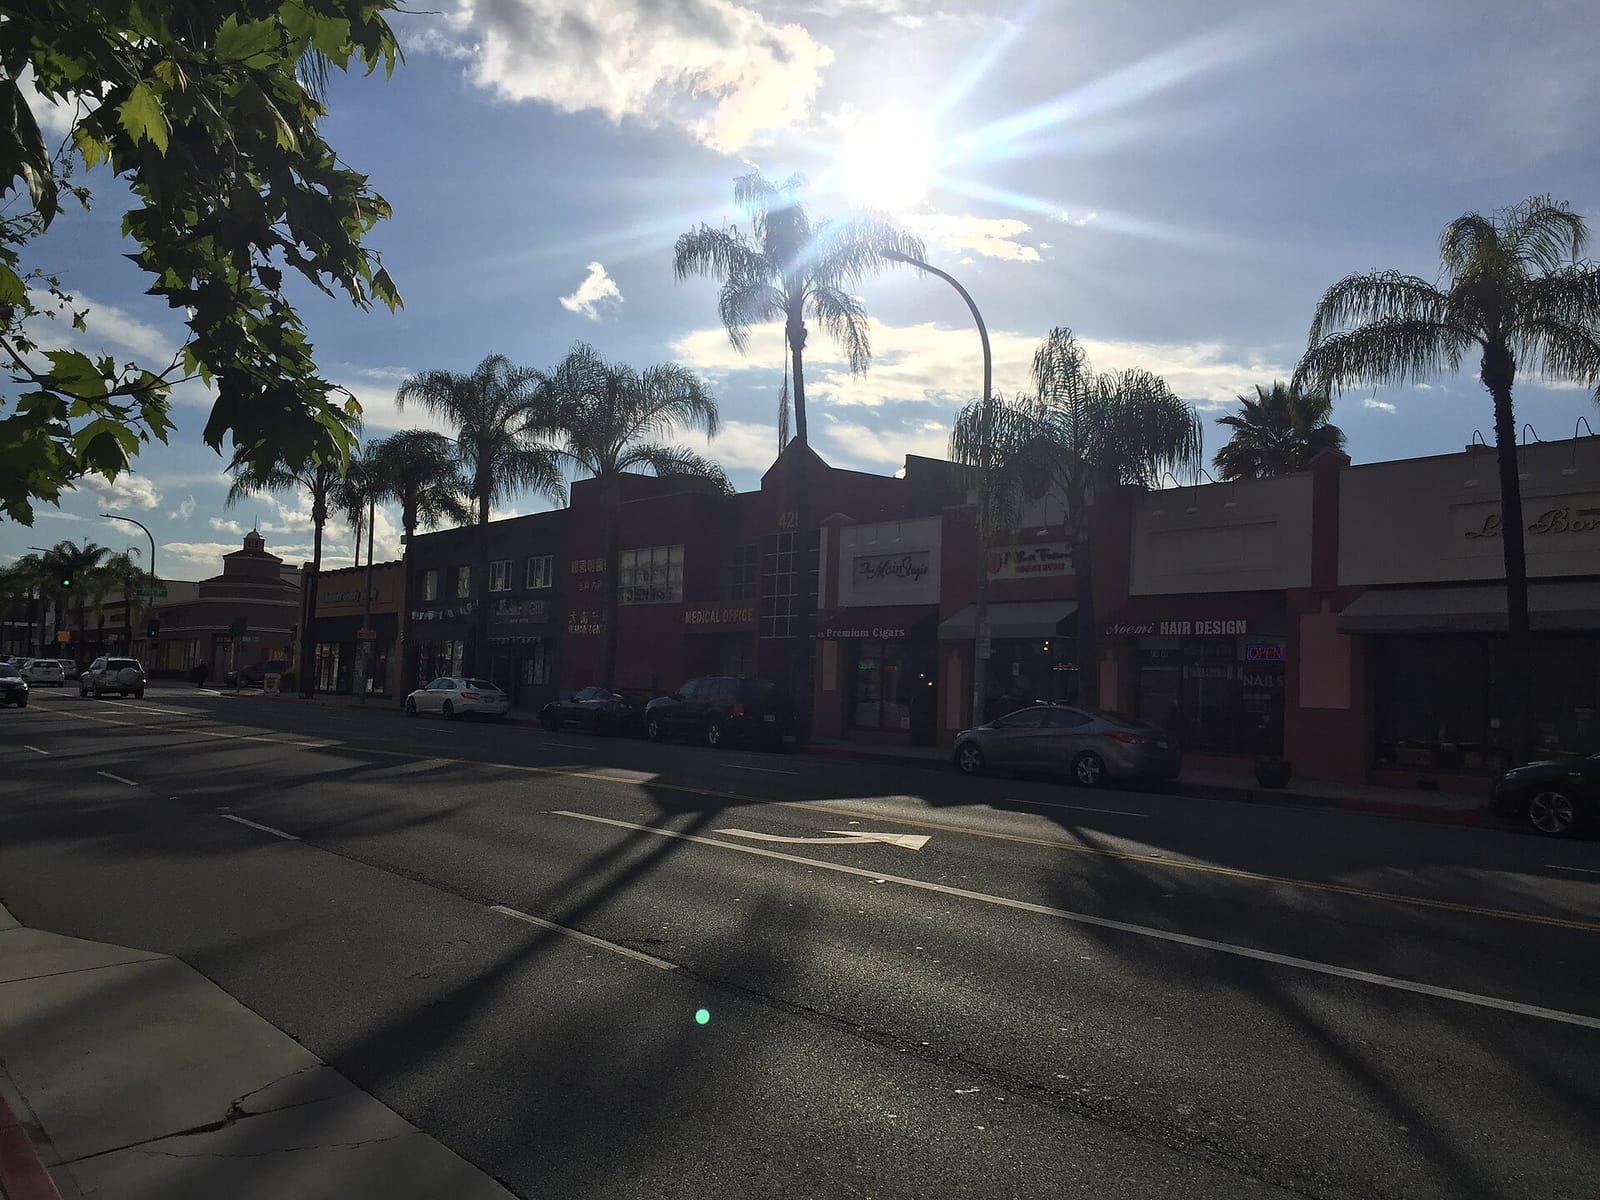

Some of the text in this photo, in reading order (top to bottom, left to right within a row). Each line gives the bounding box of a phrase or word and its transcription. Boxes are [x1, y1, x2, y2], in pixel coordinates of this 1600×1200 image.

[685, 608, 754, 624] MEDICAL OFFICE
[826, 628, 869, 638] Premium
[872, 627, 905, 640] Cigars
[1160, 621, 1191, 635] HAIR
[1195, 619, 1247, 635] DESIGN
[1249, 647, 1281, 659] OPEN
[1243, 674, 1285, 688] NAILS
